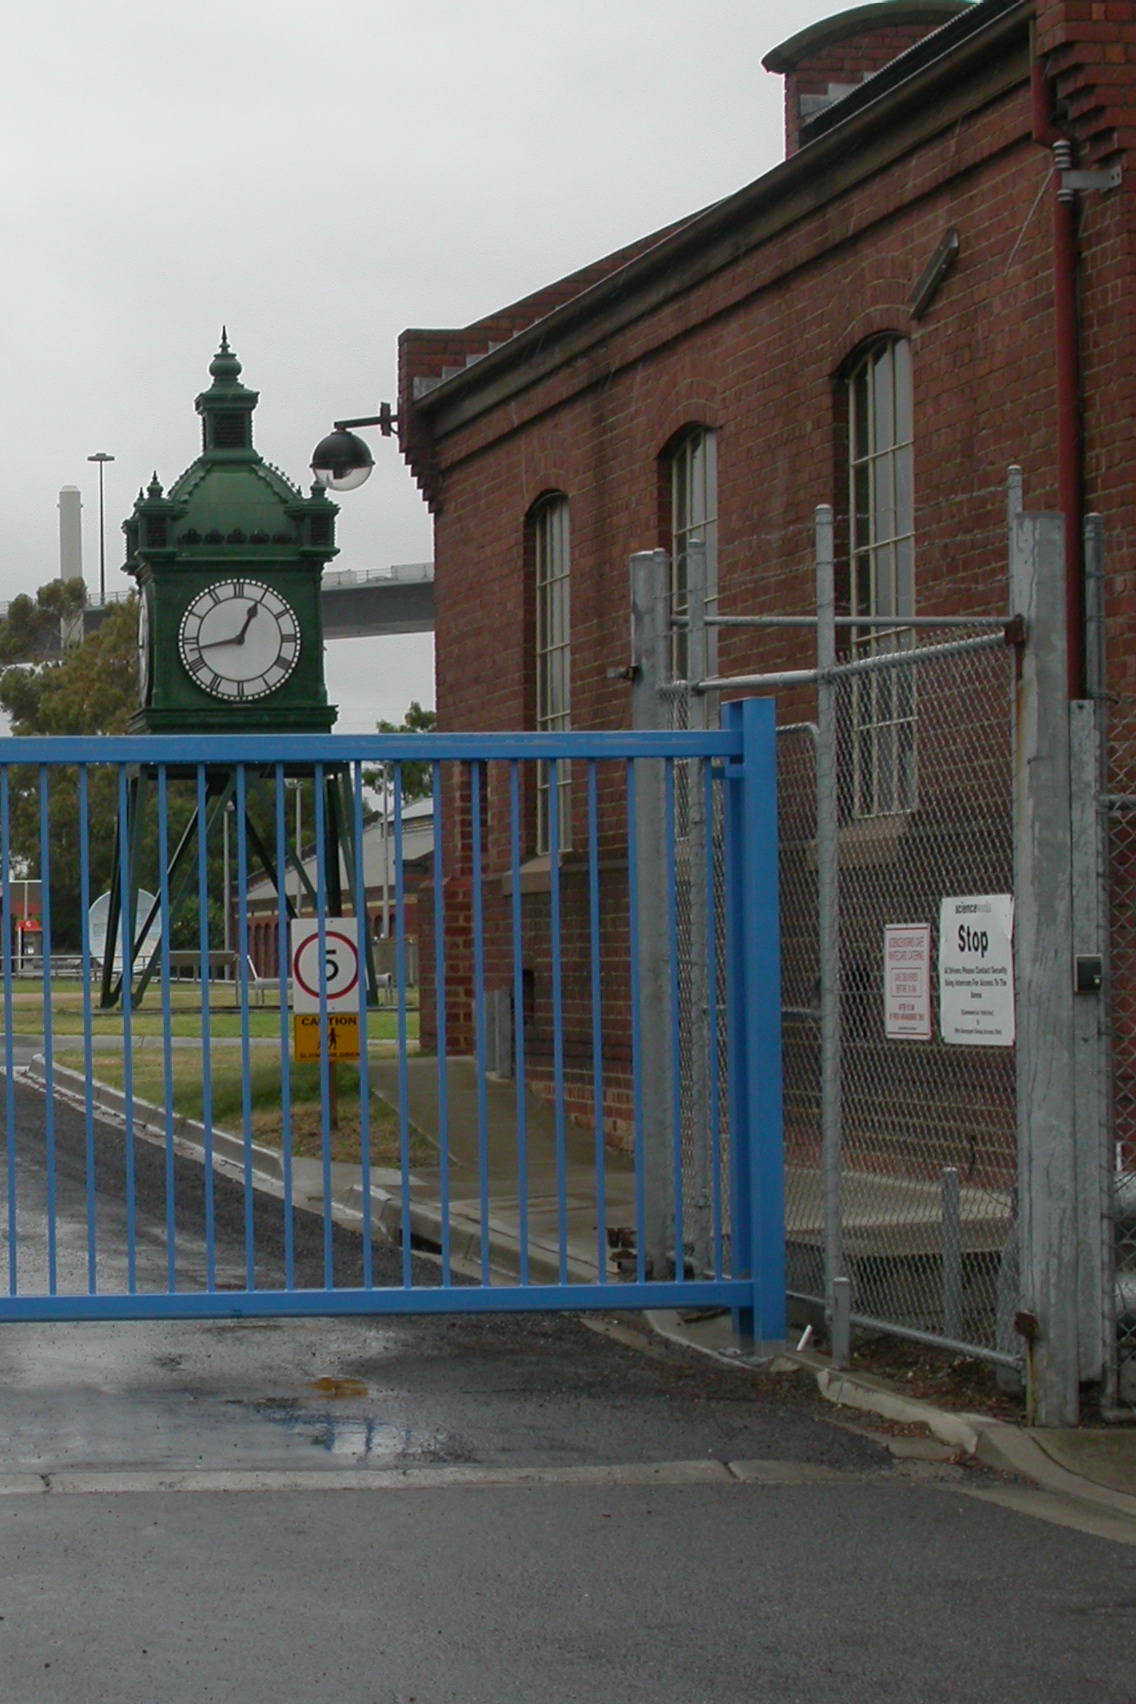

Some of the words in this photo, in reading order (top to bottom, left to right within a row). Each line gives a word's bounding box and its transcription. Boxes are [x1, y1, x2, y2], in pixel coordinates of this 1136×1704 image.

[958, 923, 989, 958] Stop
[319, 949, 339, 982] 5
[301, 1016, 357, 1026] CATION
